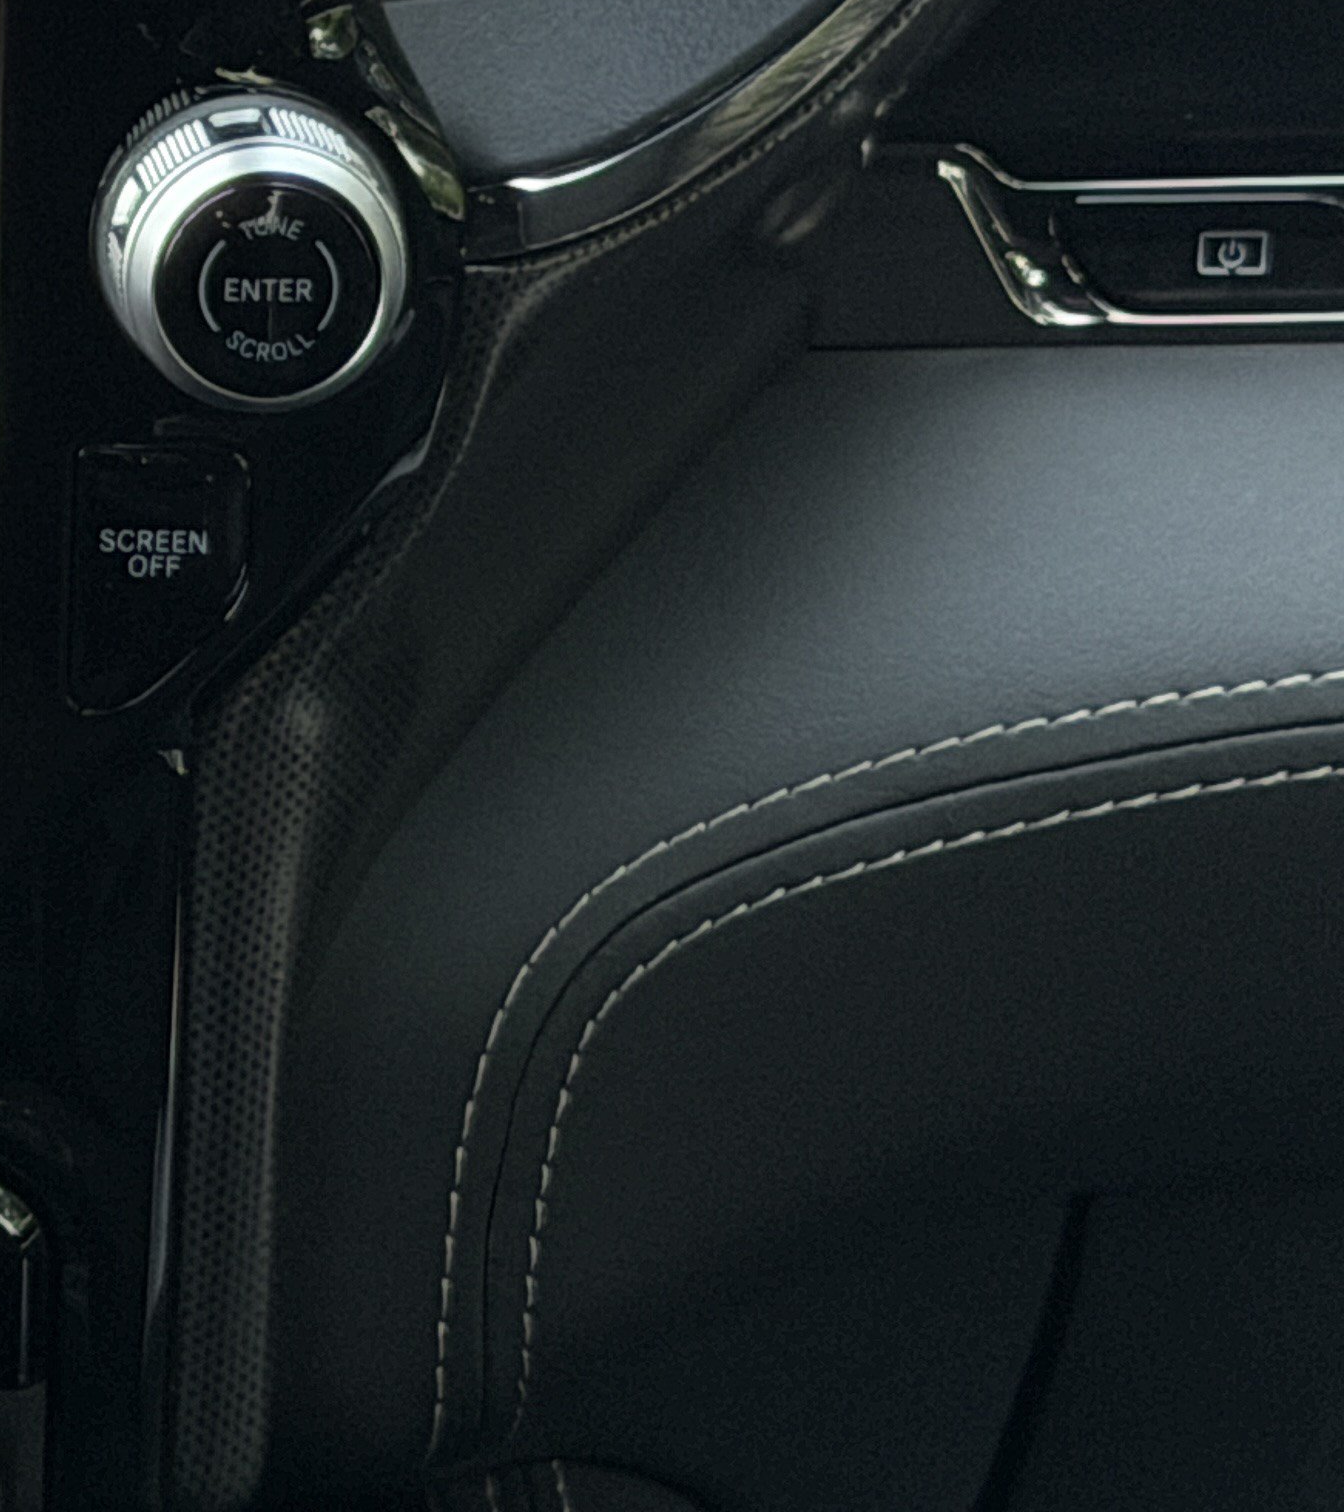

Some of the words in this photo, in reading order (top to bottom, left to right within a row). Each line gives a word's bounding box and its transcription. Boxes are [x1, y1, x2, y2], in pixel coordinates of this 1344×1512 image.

[239, 217, 305, 240] TUNE
[224, 279, 312, 302] ENTER
[226, 330, 316, 361] SCROLL
[100, 529, 208, 554] SCREEN
[128, 556, 180, 579] OFF
